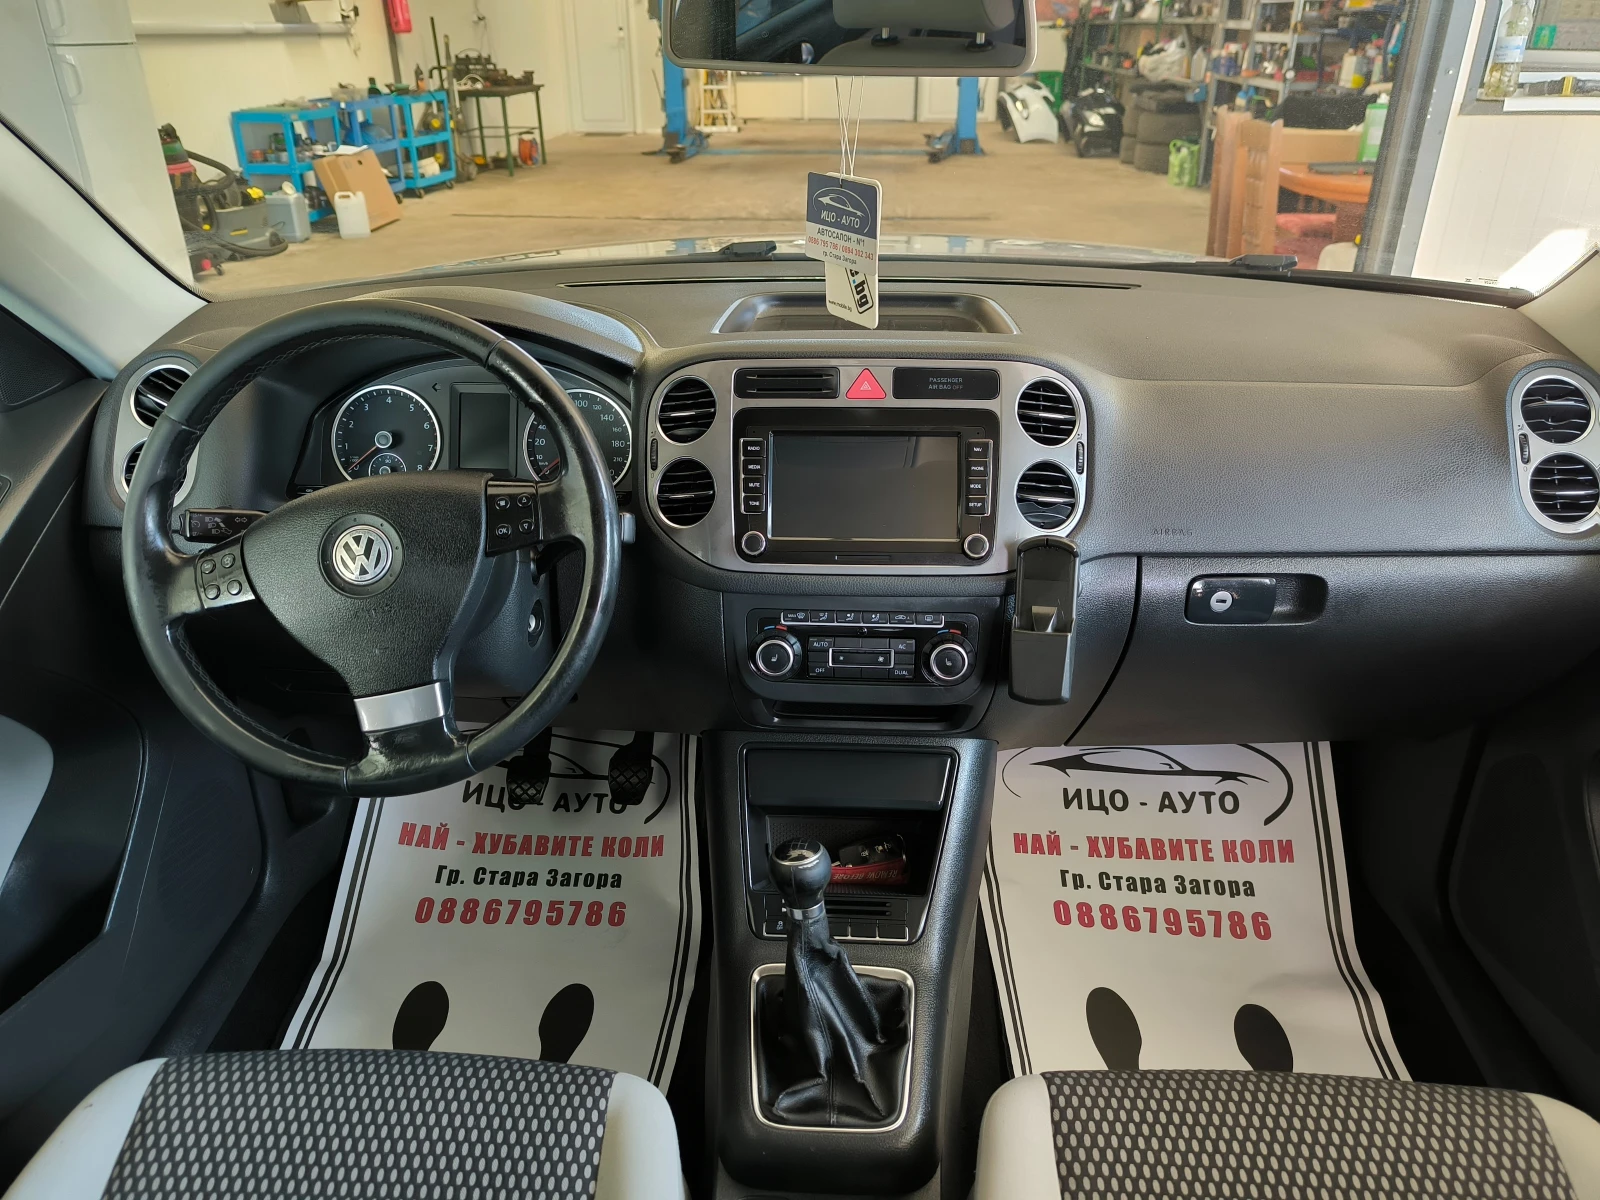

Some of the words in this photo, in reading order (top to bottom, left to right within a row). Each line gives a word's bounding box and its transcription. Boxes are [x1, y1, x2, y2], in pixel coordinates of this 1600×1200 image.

[820, 210, 836, 222] ИЦО
[840, 215, 860, 228] АУТО
[817, 227, 852, 244] АВТОСАЛОН
[386, 396, 392, 404] 4
[424, 422, 430, 430] 6
[1062, 787, 1130, 816] ИЦО
[1158, 790, 1240, 814] АУТО
[398, 822, 450, 850] НАЙ
[472, 832, 594, 857] ХУБАВИТЕ
[601, 835, 664, 858] КОЛИ
[1013, 830, 1062, 856] НАЙ
[1086, 836, 1215, 862] ХУБАВИТЕ
[1222, 839, 1294, 864] КОЛИ
[434, 864, 464, 887] Гр.
[473, 866, 539, 888] Стара
[546, 868, 622, 889] Загора
[1060, 869, 1092, 890] Гр.
[1098, 871, 1167, 895] Стара
[1174, 874, 1256, 898] Загора
[414, 896, 627, 927] 0886795786
[1053, 900, 1272, 940] 0886795786
